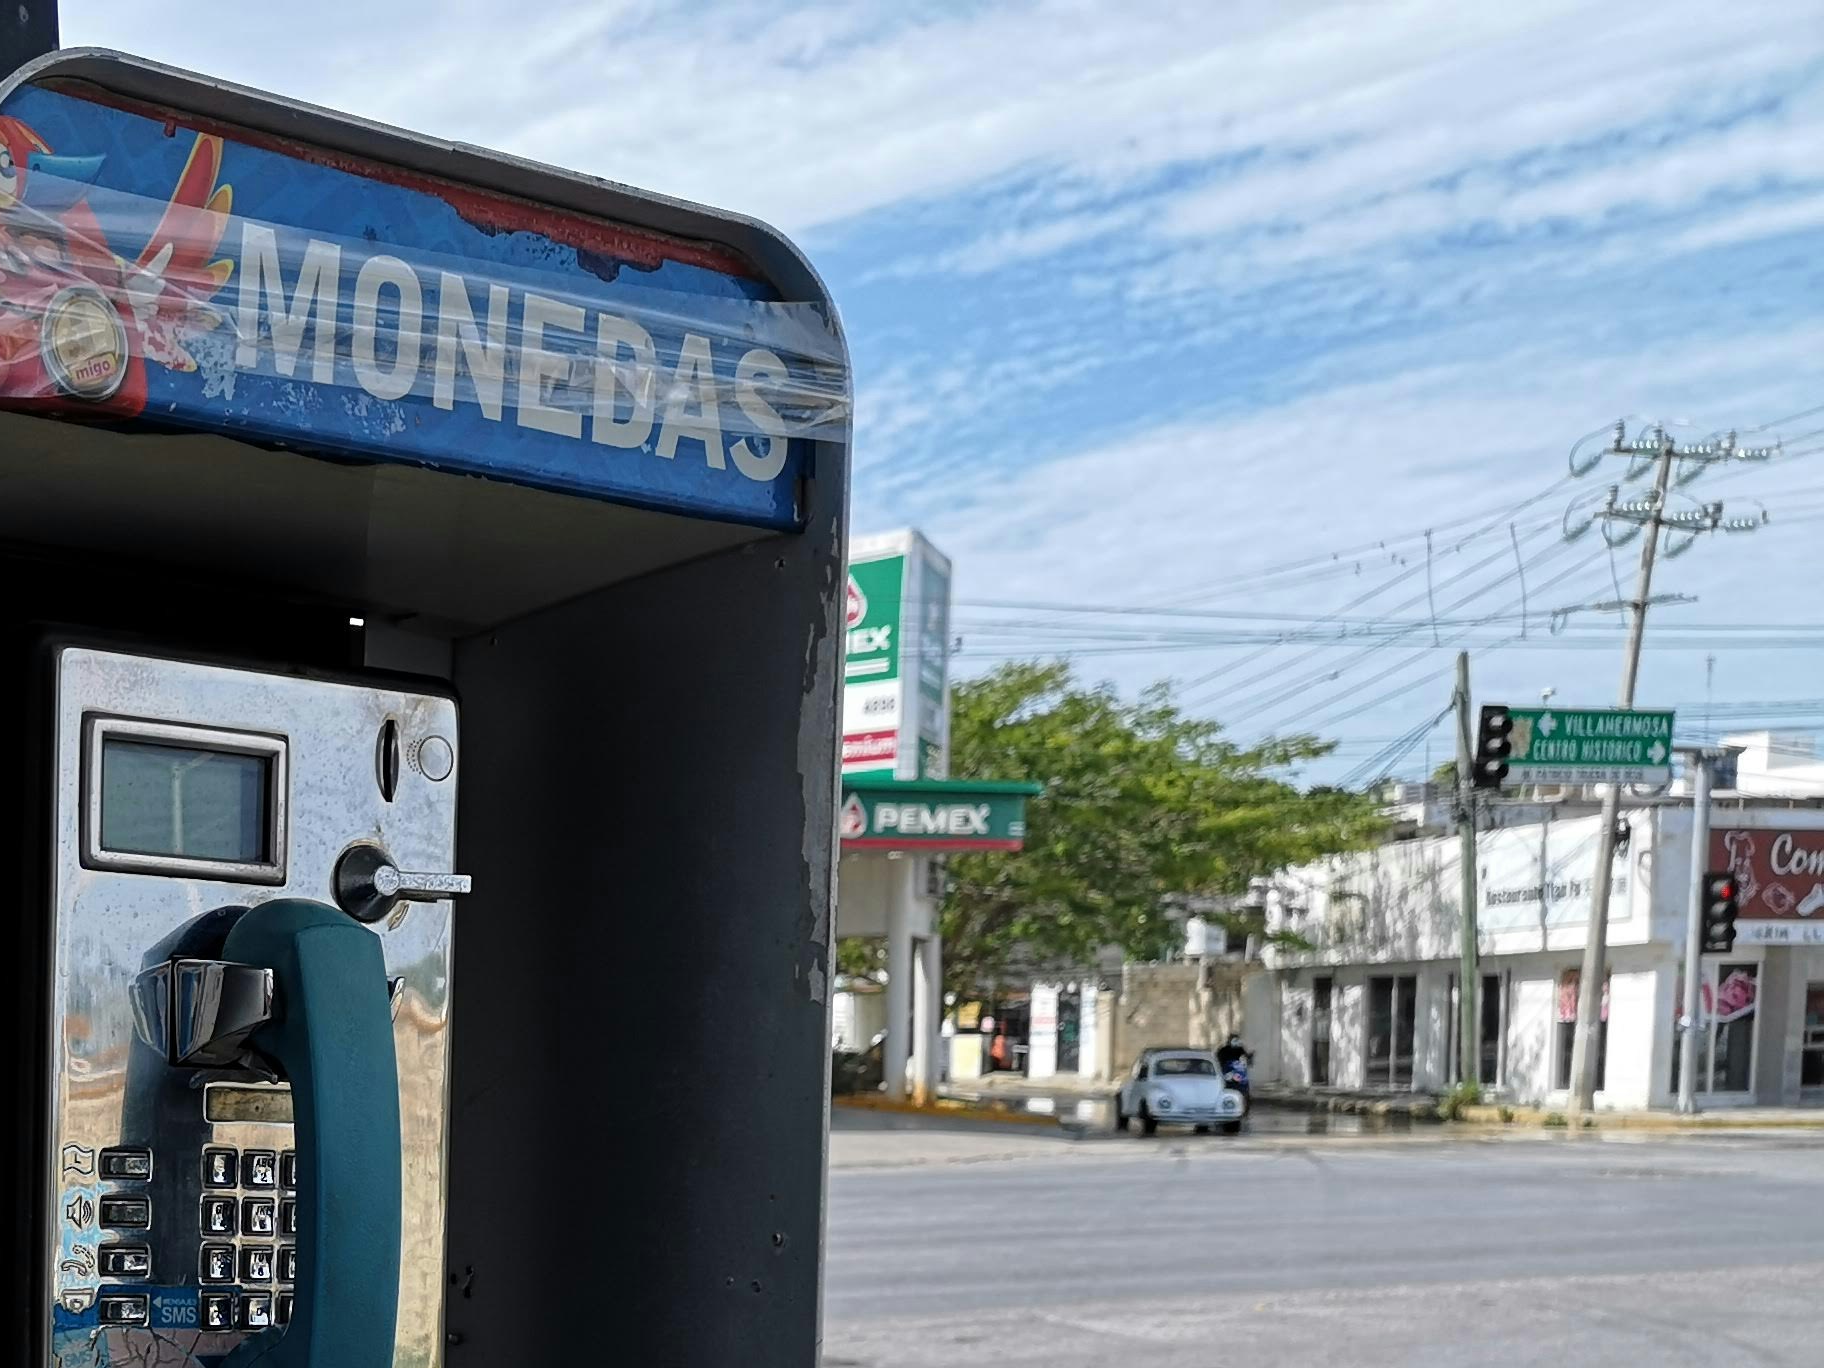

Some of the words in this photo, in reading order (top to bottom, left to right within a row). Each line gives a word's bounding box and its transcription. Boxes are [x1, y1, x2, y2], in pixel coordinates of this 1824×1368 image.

[236, 221, 791, 483] MONEDAS
[76, 359, 111, 380] migo
[1565, 714, 1668, 738] VILLAHERMOSA
[1533, 738, 1576, 761] CENTRO
[875, 803, 991, 834] PEMEX
[261, 1173, 268, 1182] 2
[161, 1307, 196, 1323] SMS
